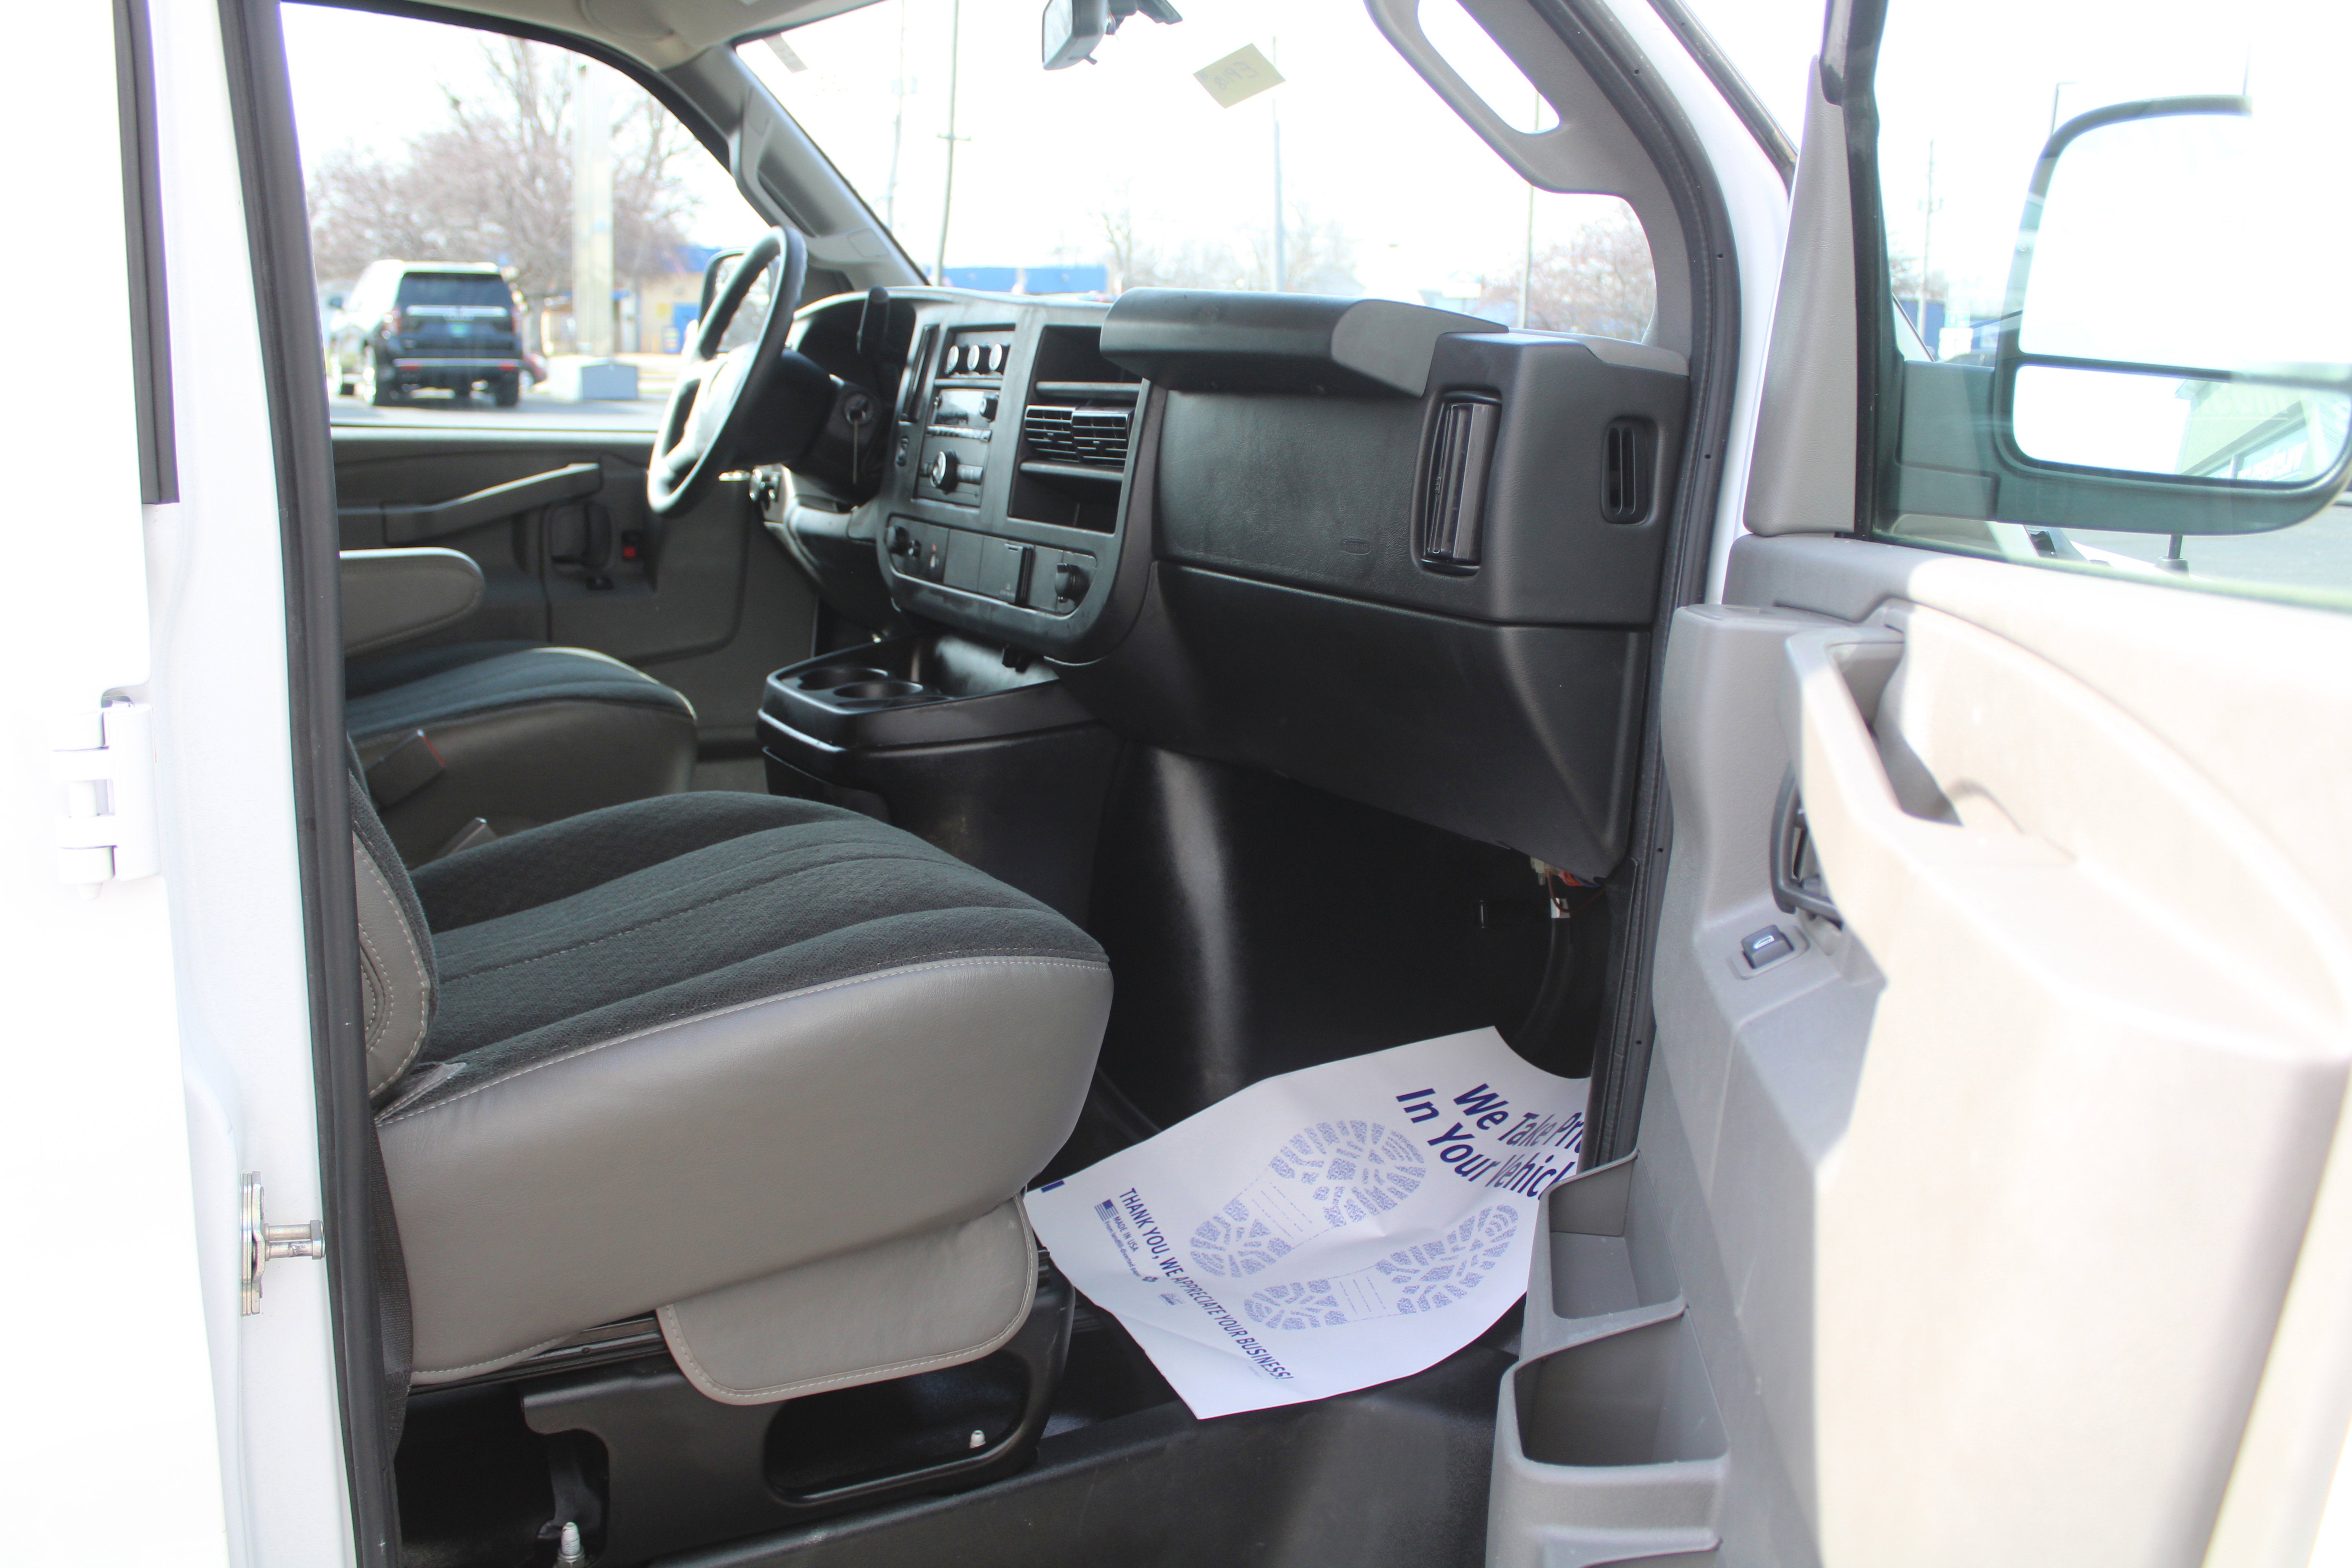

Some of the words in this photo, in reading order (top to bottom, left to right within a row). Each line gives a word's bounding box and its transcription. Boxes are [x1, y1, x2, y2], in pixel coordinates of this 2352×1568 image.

[1453, 1083, 1509, 1130] We
[1497, 1112, 1558, 1147] Take
[1395, 1088, 1440, 1124] In
[1427, 1122, 1501, 1182] Your
[1119, 1187, 1155, 1229] THANK
[1104, 1221, 1113, 1233] From
[1113, 1216, 1128, 1233] MADE
[1123, 1232, 1132, 1240] IN
[1127, 1239, 1139, 1252] USA
[1142, 1227, 1171, 1260] YOU,
[1159, 1256, 1184, 1277] WE
[1171, 1276, 1227, 1315] APPRECIATE
[1214, 1314, 1248, 1337] YOUR
[1235, 1337, 1294, 1379] BUSINESS!
